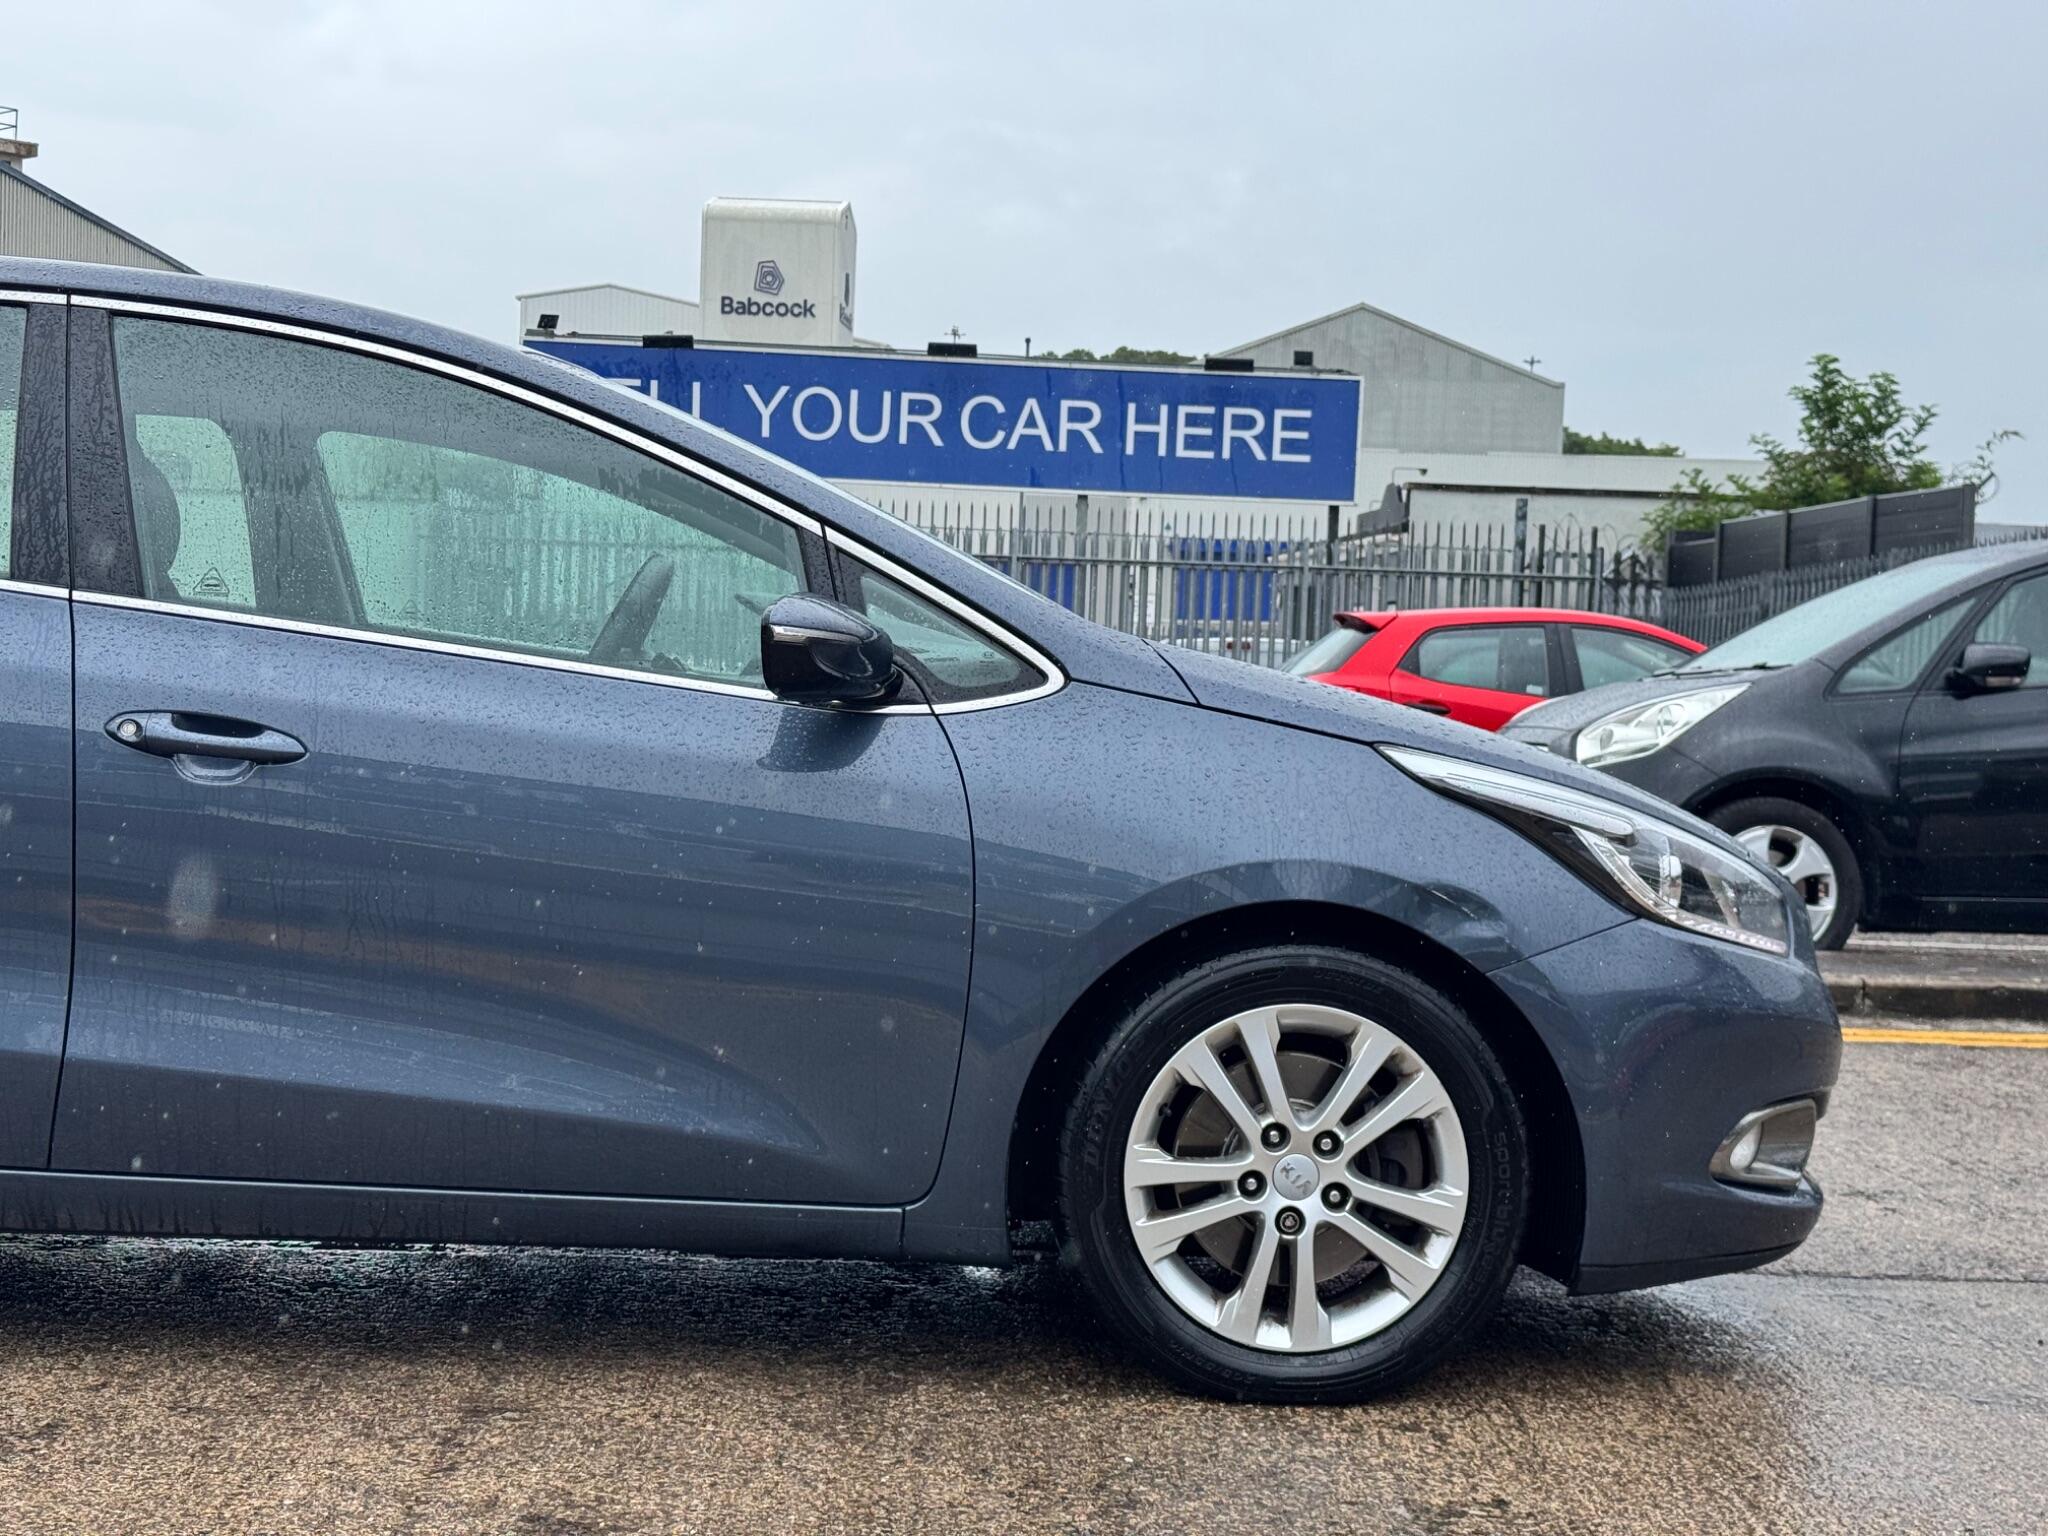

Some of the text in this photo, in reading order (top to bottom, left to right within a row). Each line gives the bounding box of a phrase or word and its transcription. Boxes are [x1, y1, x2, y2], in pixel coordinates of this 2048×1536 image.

[720, 295, 816, 319] Babcock
[743, 384, 945, 447] YOUR
[960, 395, 1104, 454] CAR
[1125, 402, 1313, 463] HERE
[1279, 1161, 1312, 1196] KIA
